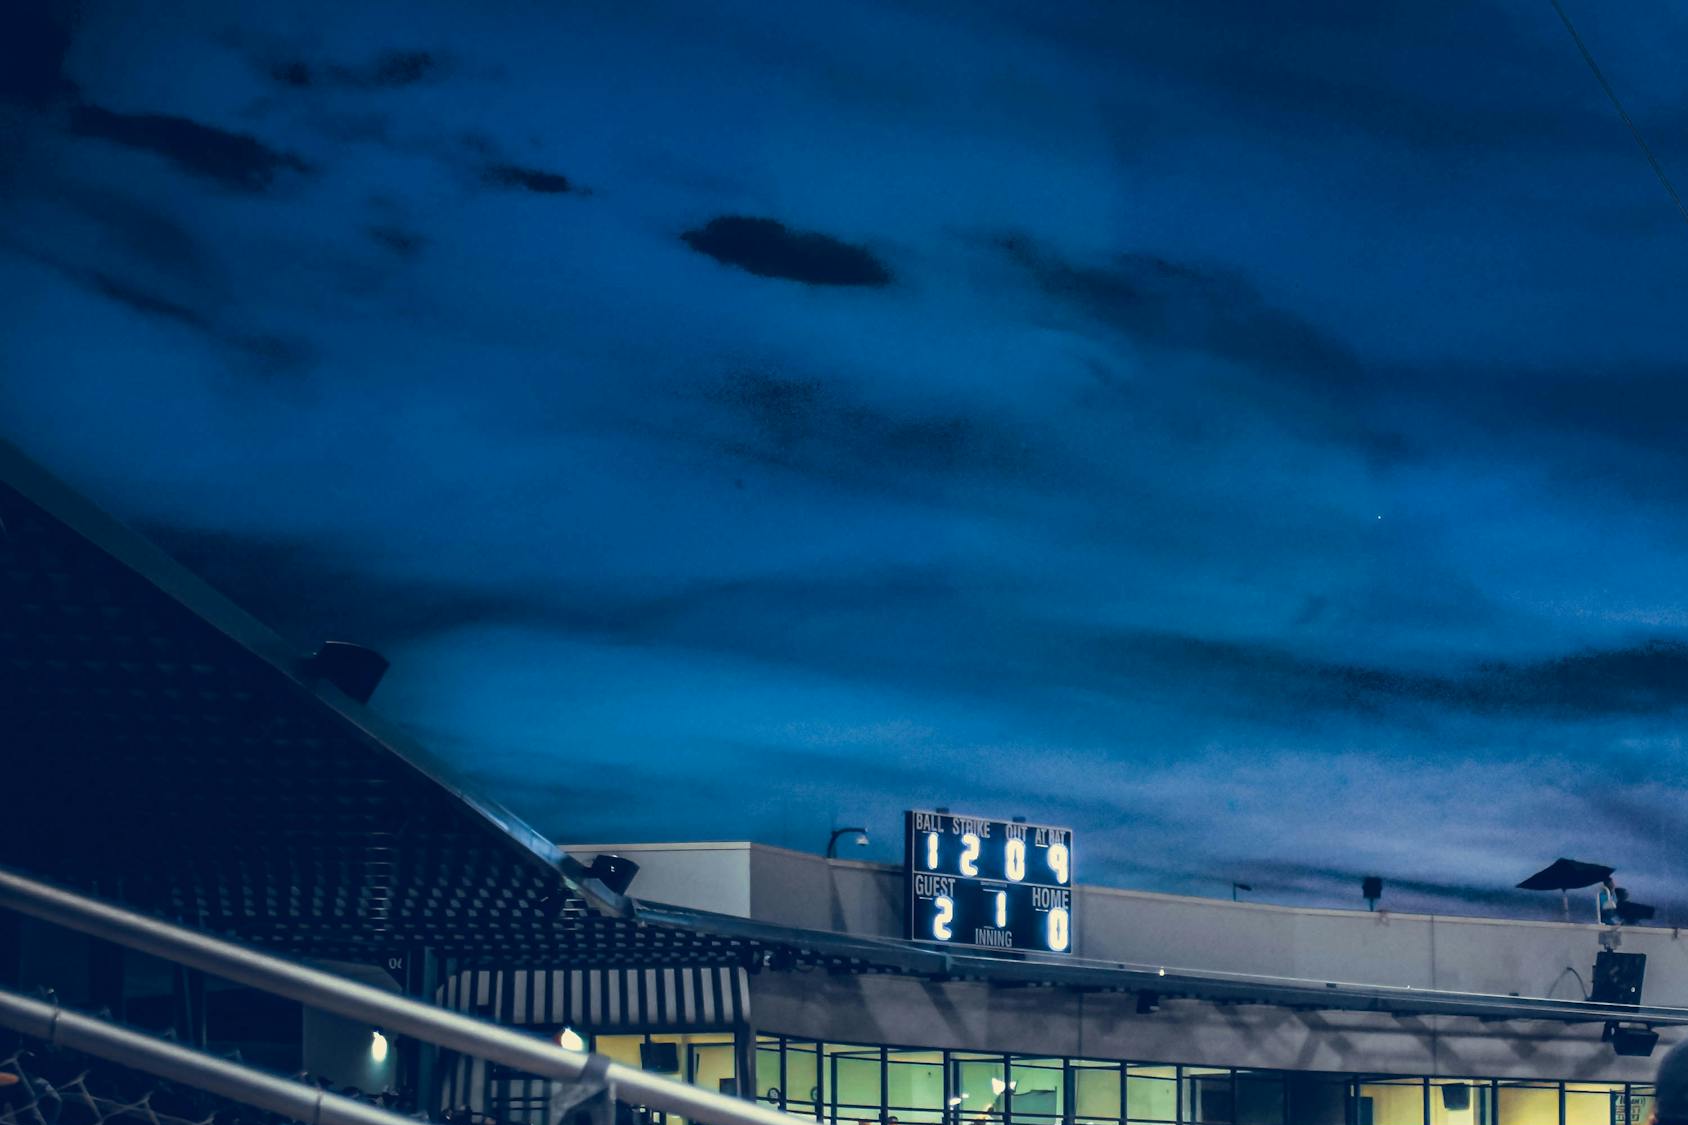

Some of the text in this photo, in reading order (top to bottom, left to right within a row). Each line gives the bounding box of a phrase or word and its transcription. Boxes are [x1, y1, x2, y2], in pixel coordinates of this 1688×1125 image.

[915, 813, 1066, 845] BALL STRIKE OUT AT BAT
[928, 832, 1069, 884] 1 2 0 9
[915, 875, 1070, 910] GUEST HOME
[933, 890, 1069, 952] 2 1 0
[975, 928, 1013, 948] INNING
